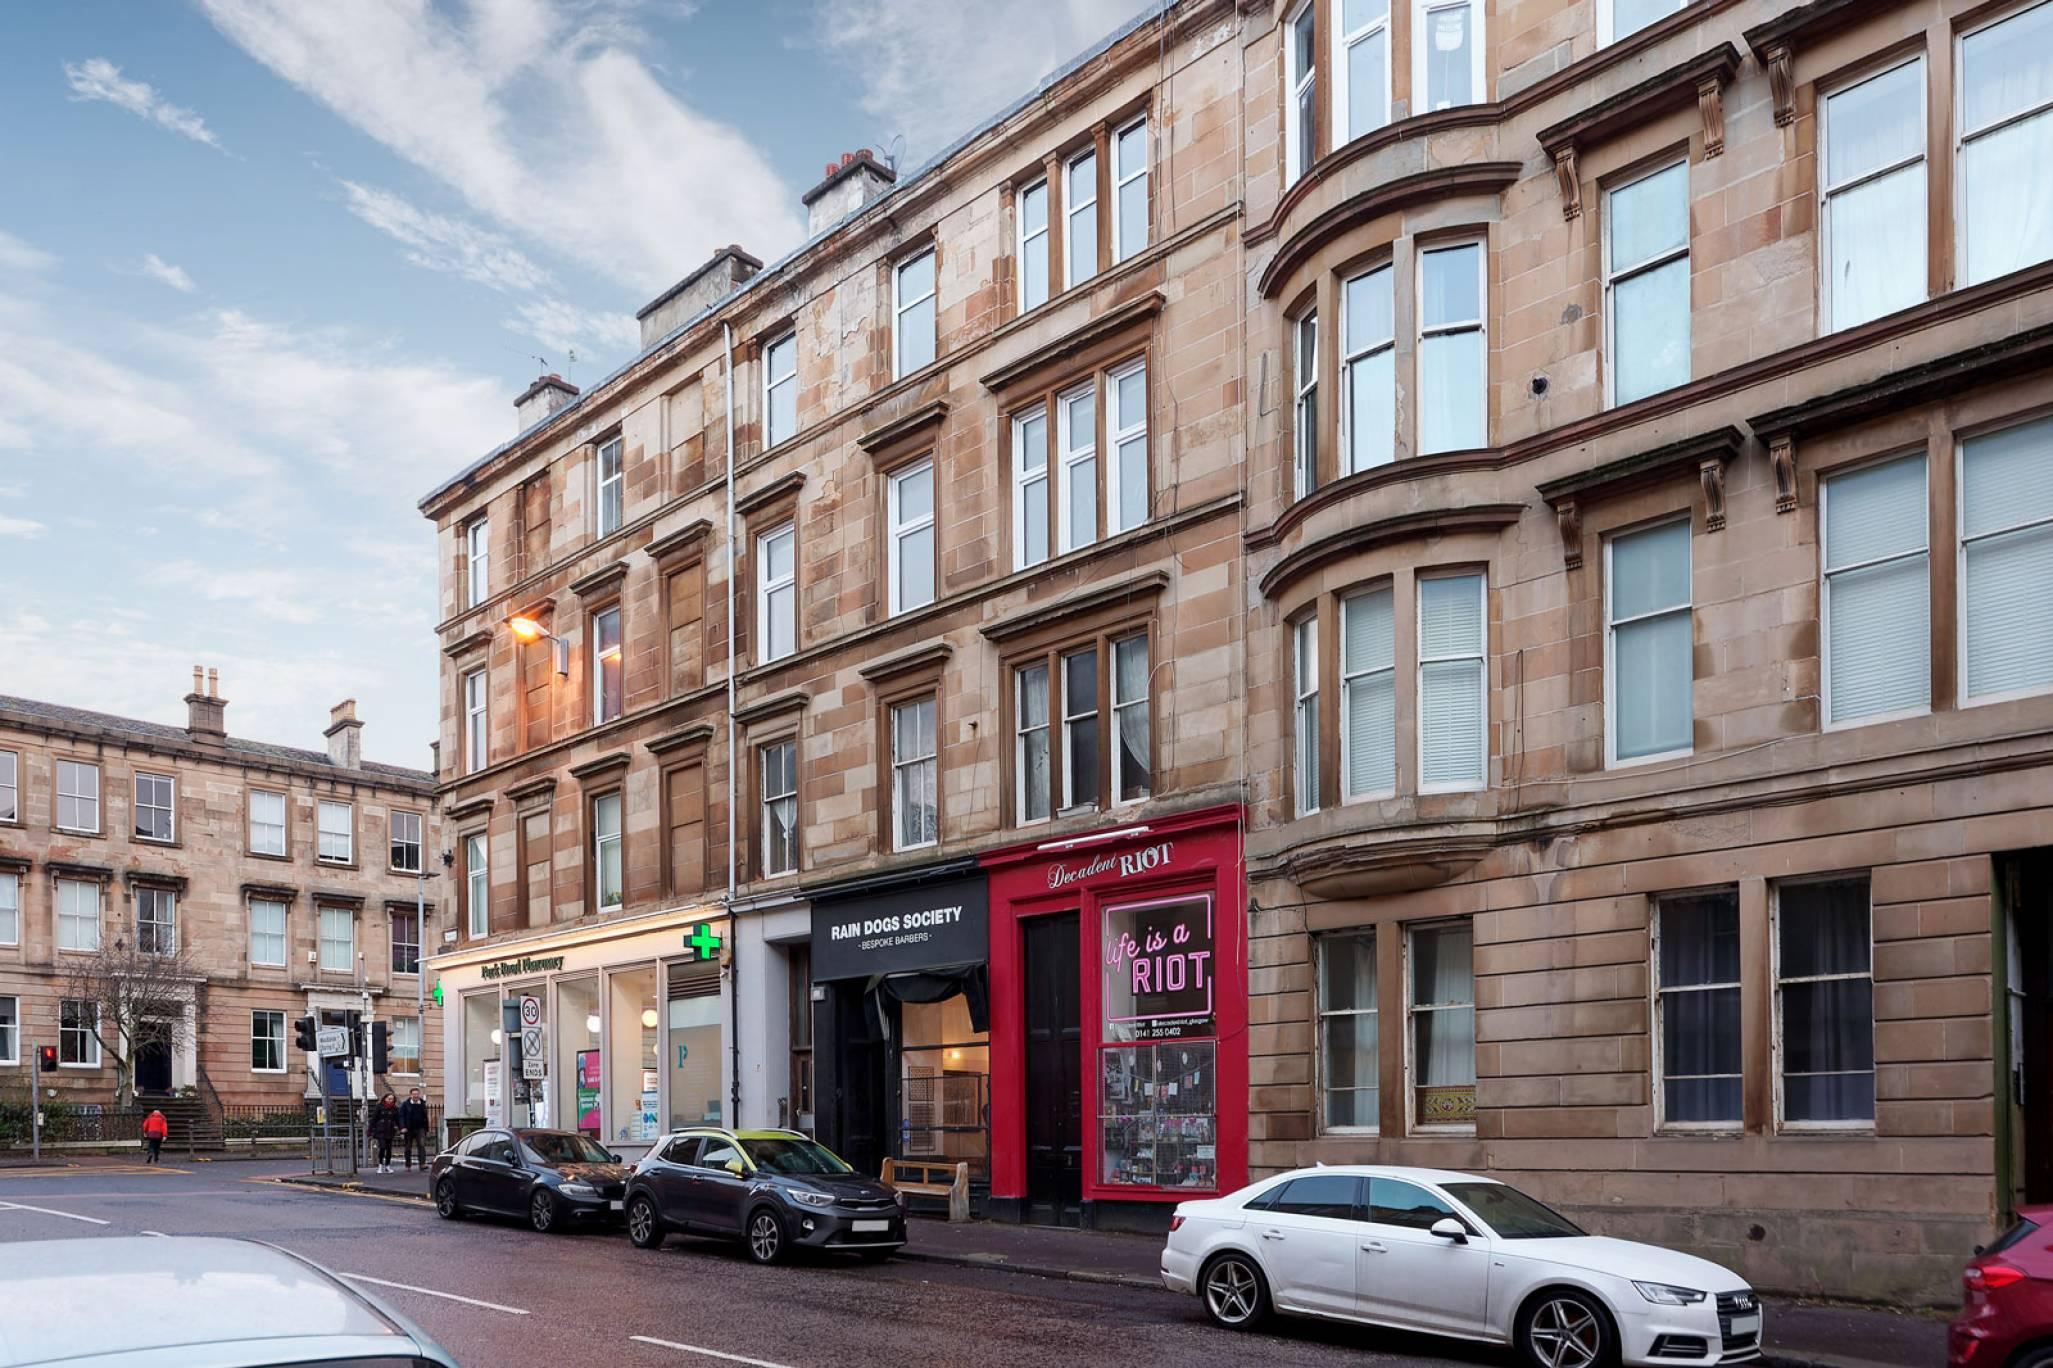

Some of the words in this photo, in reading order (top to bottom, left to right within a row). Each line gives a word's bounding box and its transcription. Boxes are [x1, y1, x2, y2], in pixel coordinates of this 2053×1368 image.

[1048, 852, 1117, 889] Decadent
[1119, 842, 1174, 877] RIOT
[831, 922, 861, 940] RAIN
[864, 916, 900, 935] DOGS
[903, 906, 962, 929] SOCIETY
[523, 956, 564, 974] Pharmacy
[1106, 932, 1140, 973] life
[1146, 926, 1167, 952] is
[1173, 923, 1190, 944] a
[1132, 951, 1211, 994] RIOT
[525, 1005, 537, 1017] 30
[1152, 1029, 1164, 1037] 255
[1165, 1027, 1181, 1036] 0402
